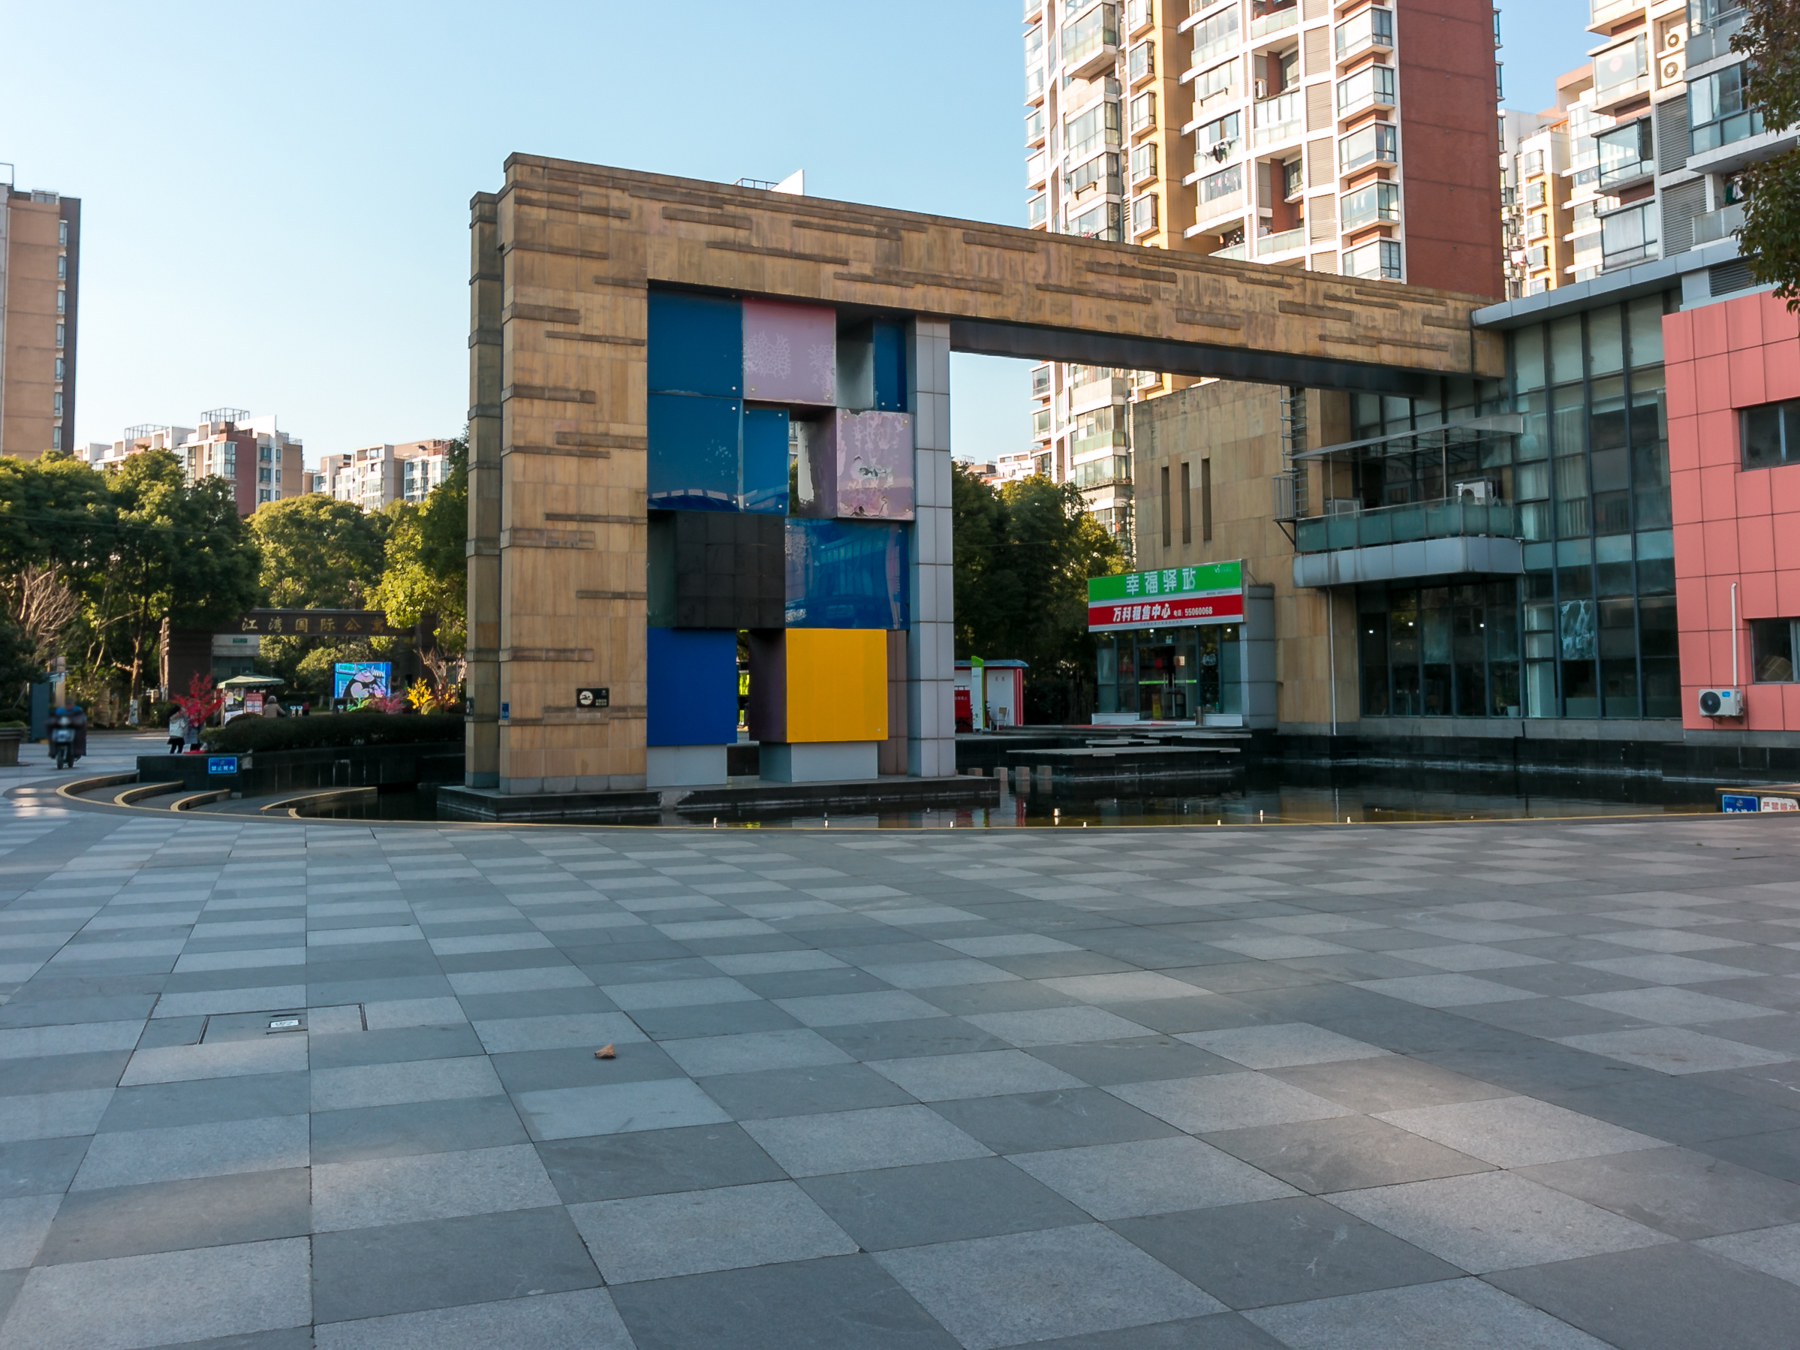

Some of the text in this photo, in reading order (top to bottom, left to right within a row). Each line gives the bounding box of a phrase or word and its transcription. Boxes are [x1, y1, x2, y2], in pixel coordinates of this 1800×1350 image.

[1126, 568, 1196, 595] 幸福驿站
[1113, 603, 1171, 622] 万科租售中心
[241, 616, 384, 633] 江湾国际公寓
